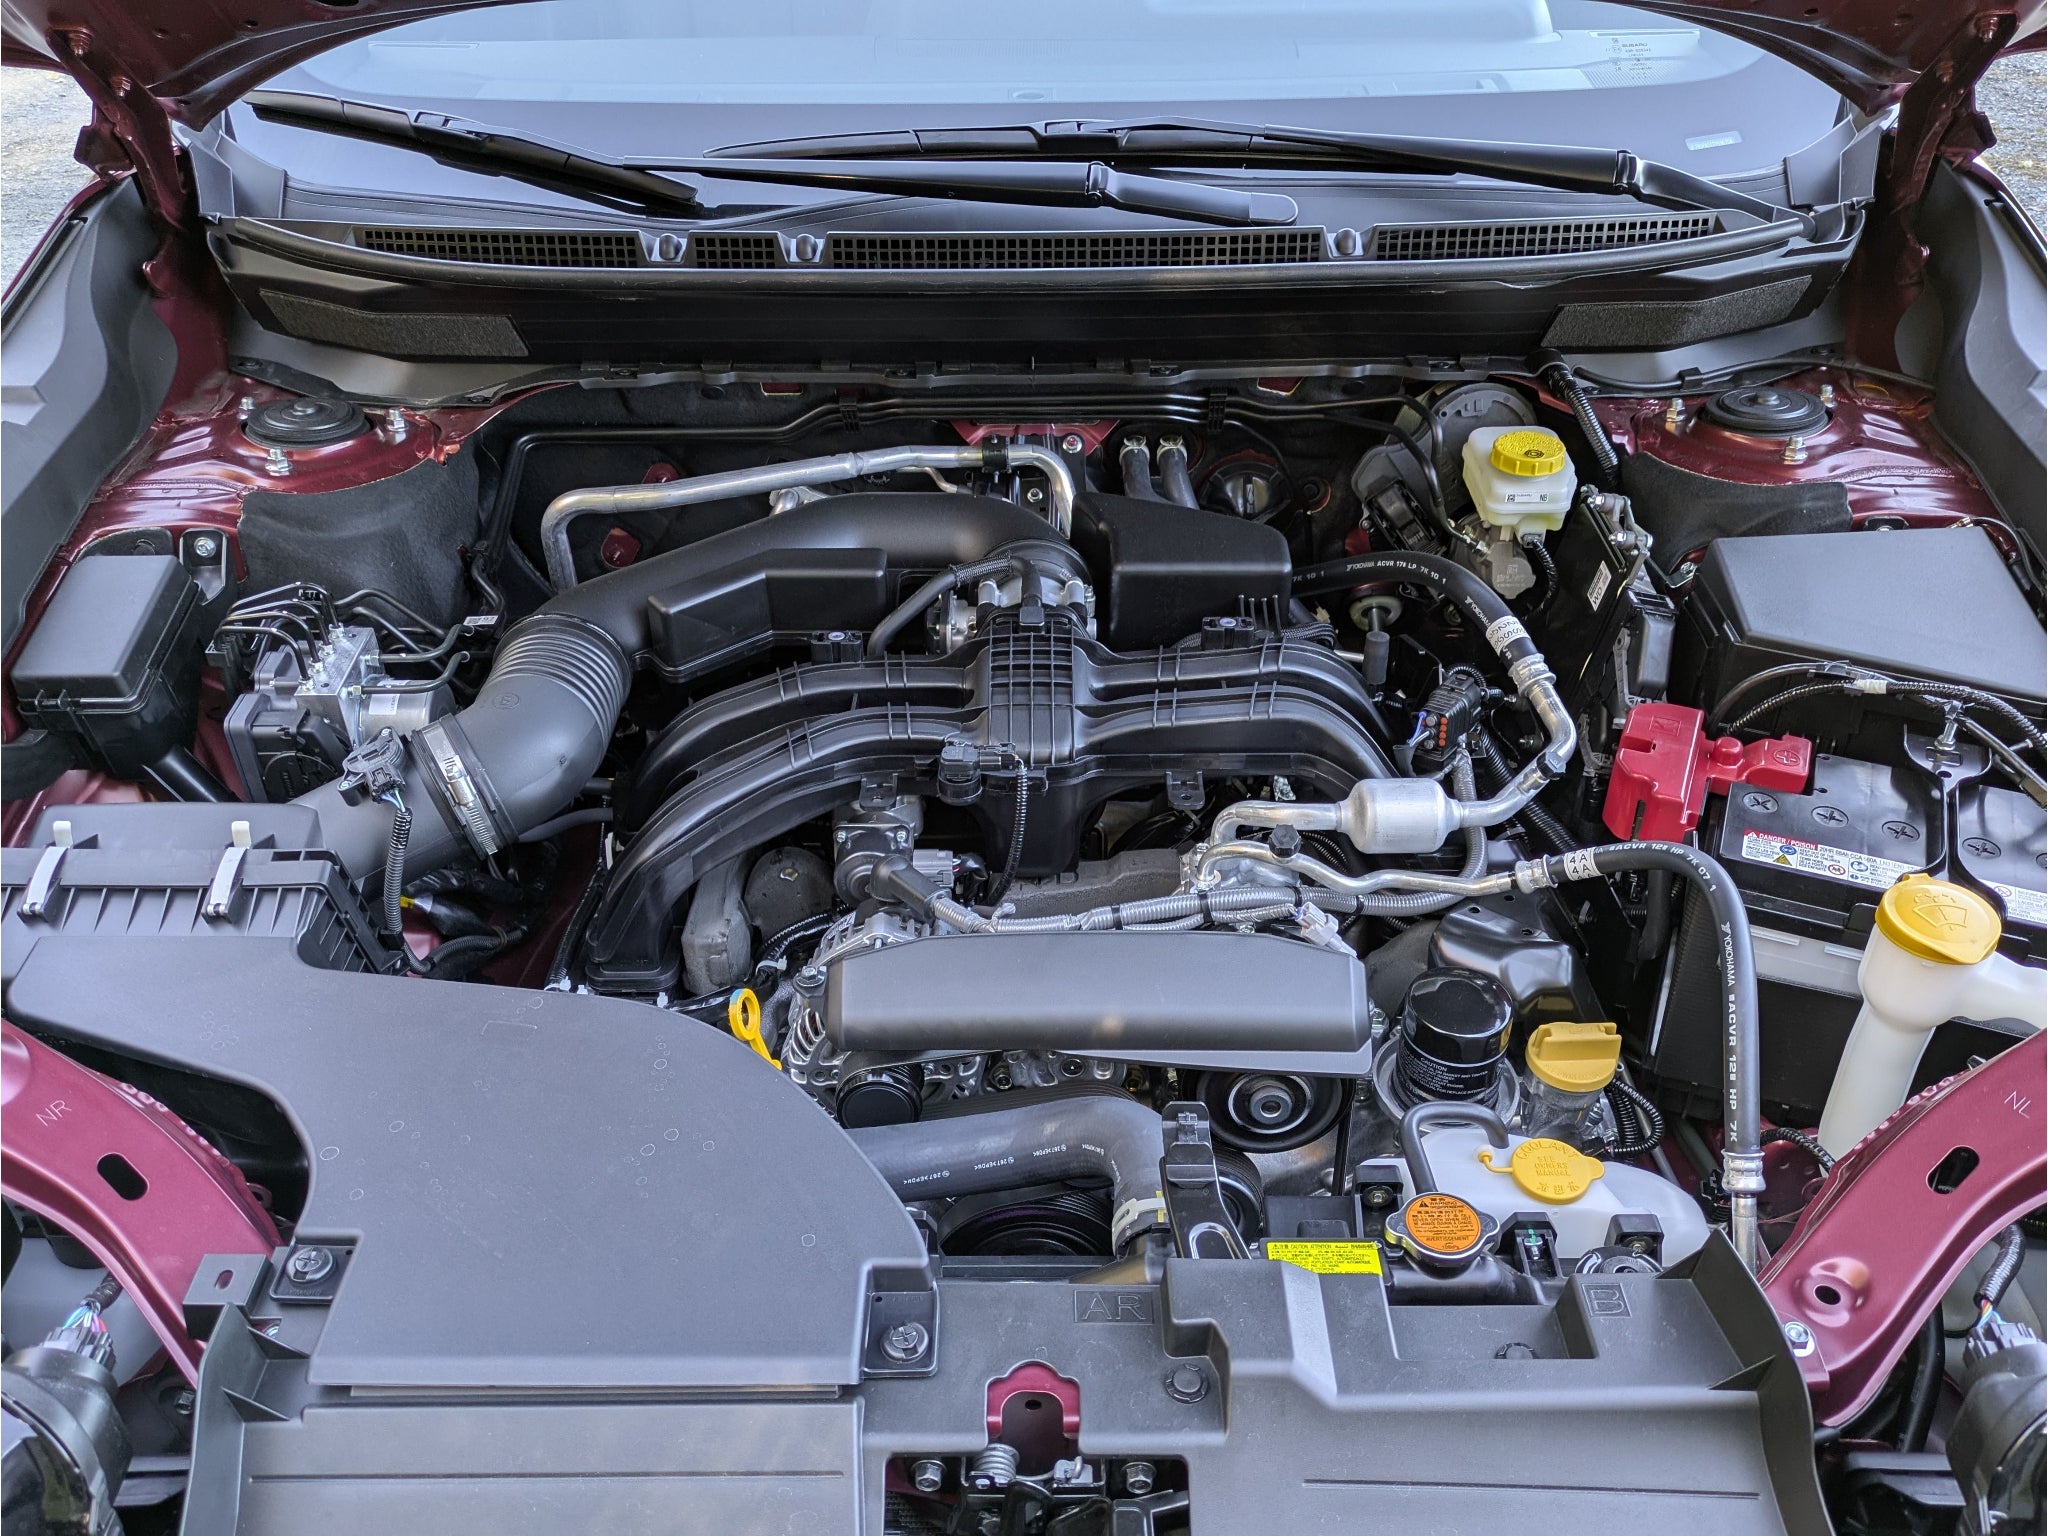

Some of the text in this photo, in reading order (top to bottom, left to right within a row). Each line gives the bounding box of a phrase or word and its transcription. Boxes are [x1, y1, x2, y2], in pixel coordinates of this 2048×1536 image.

[1759, 832, 1787, 845] DANGER
[1790, 839, 1816, 850] POISON
[1670, 846, 1685, 855] HP
[1686, 854, 1700, 866] 7K
[1723, 934, 1736, 987] YOKOHAMA
[1420, 1057, 1448, 1072] CAUTION
[1729, 1088, 1737, 1110] HP
[2004, 1091, 2032, 1119] NL
[36, 1099, 72, 1127] NR
[1729, 1120, 1738, 1143] 7K
[1516, 1140, 1578, 1159] COOLANT
[1081, 1292, 1147, 1320] AR
[1590, 1289, 1624, 1314] B
